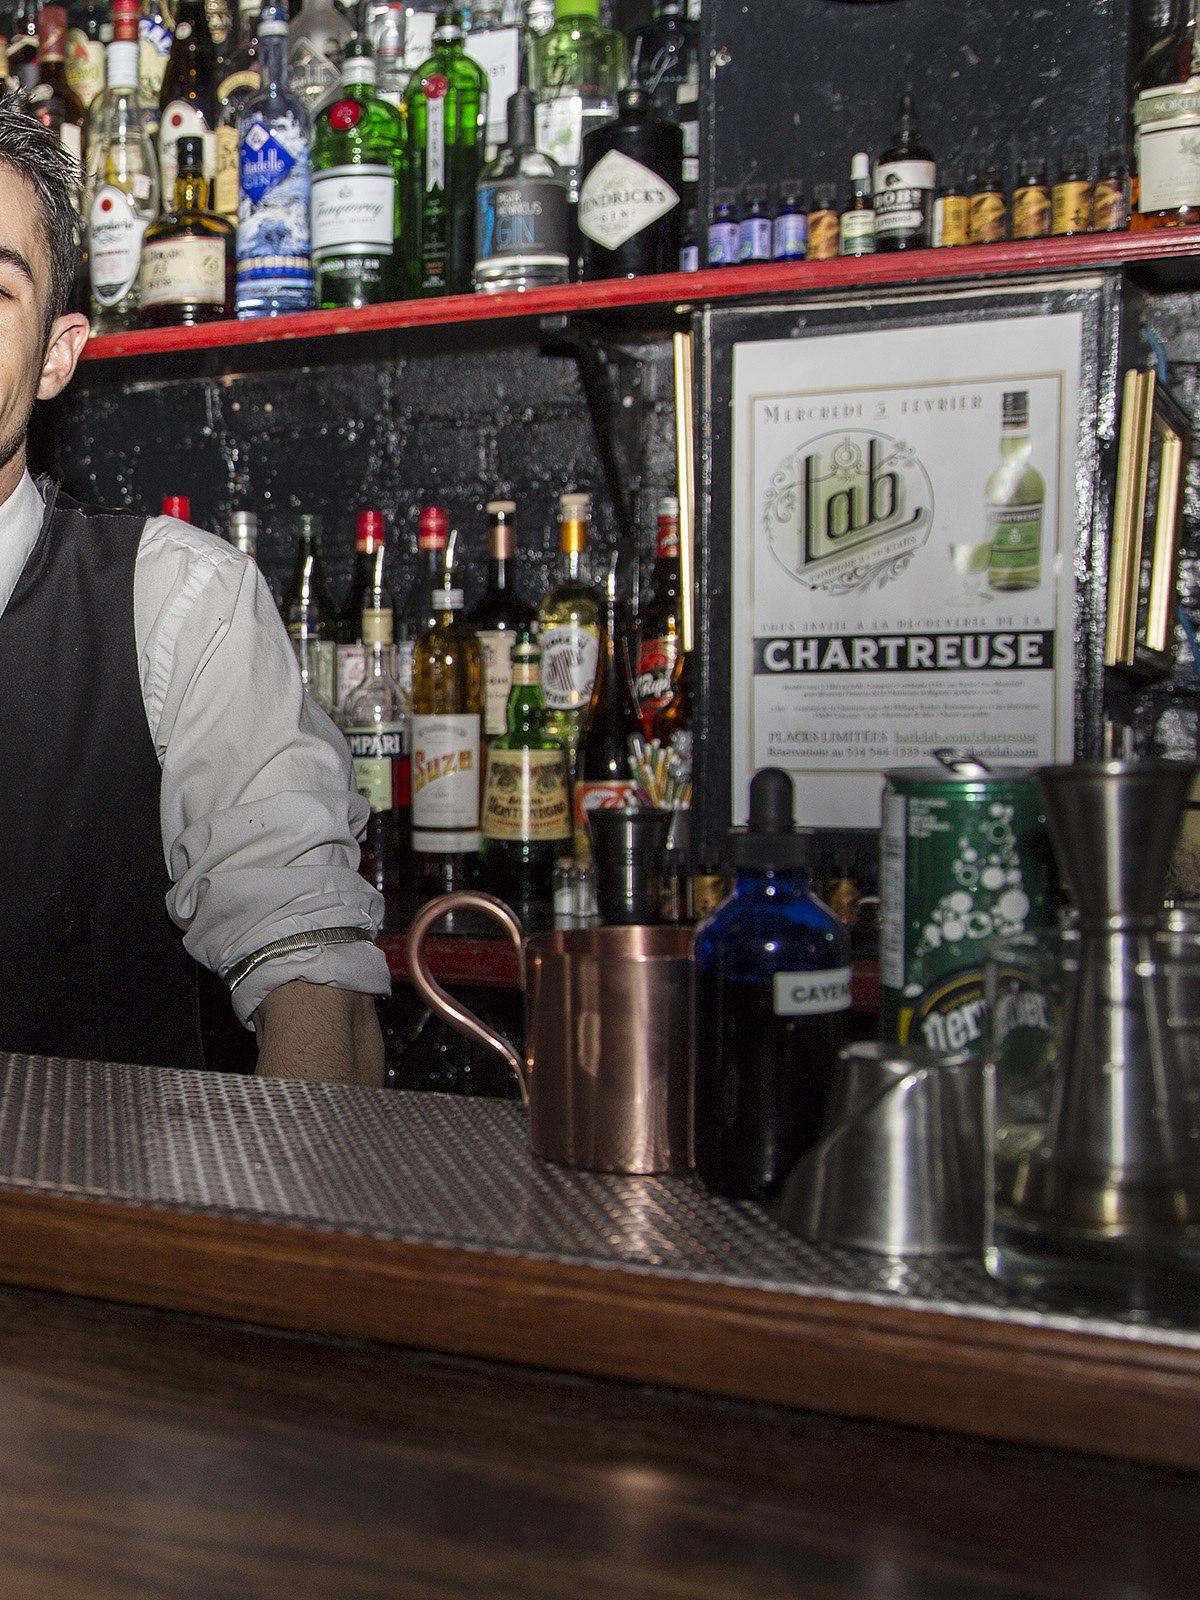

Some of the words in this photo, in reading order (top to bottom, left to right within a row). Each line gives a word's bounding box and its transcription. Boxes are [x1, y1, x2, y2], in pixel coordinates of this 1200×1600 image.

[1155, 96, 1200, 113] SORTI
[496, 215, 536, 247] GIN
[763, 403, 863, 424] MERCREDI
[803, 438, 924, 566] Lab
[762, 634, 1044, 672] CHARTREUSE
[347, 734, 400, 754] MPARI
[768, 731, 820, 743] PLACES
[414, 749, 473, 793] Suze
